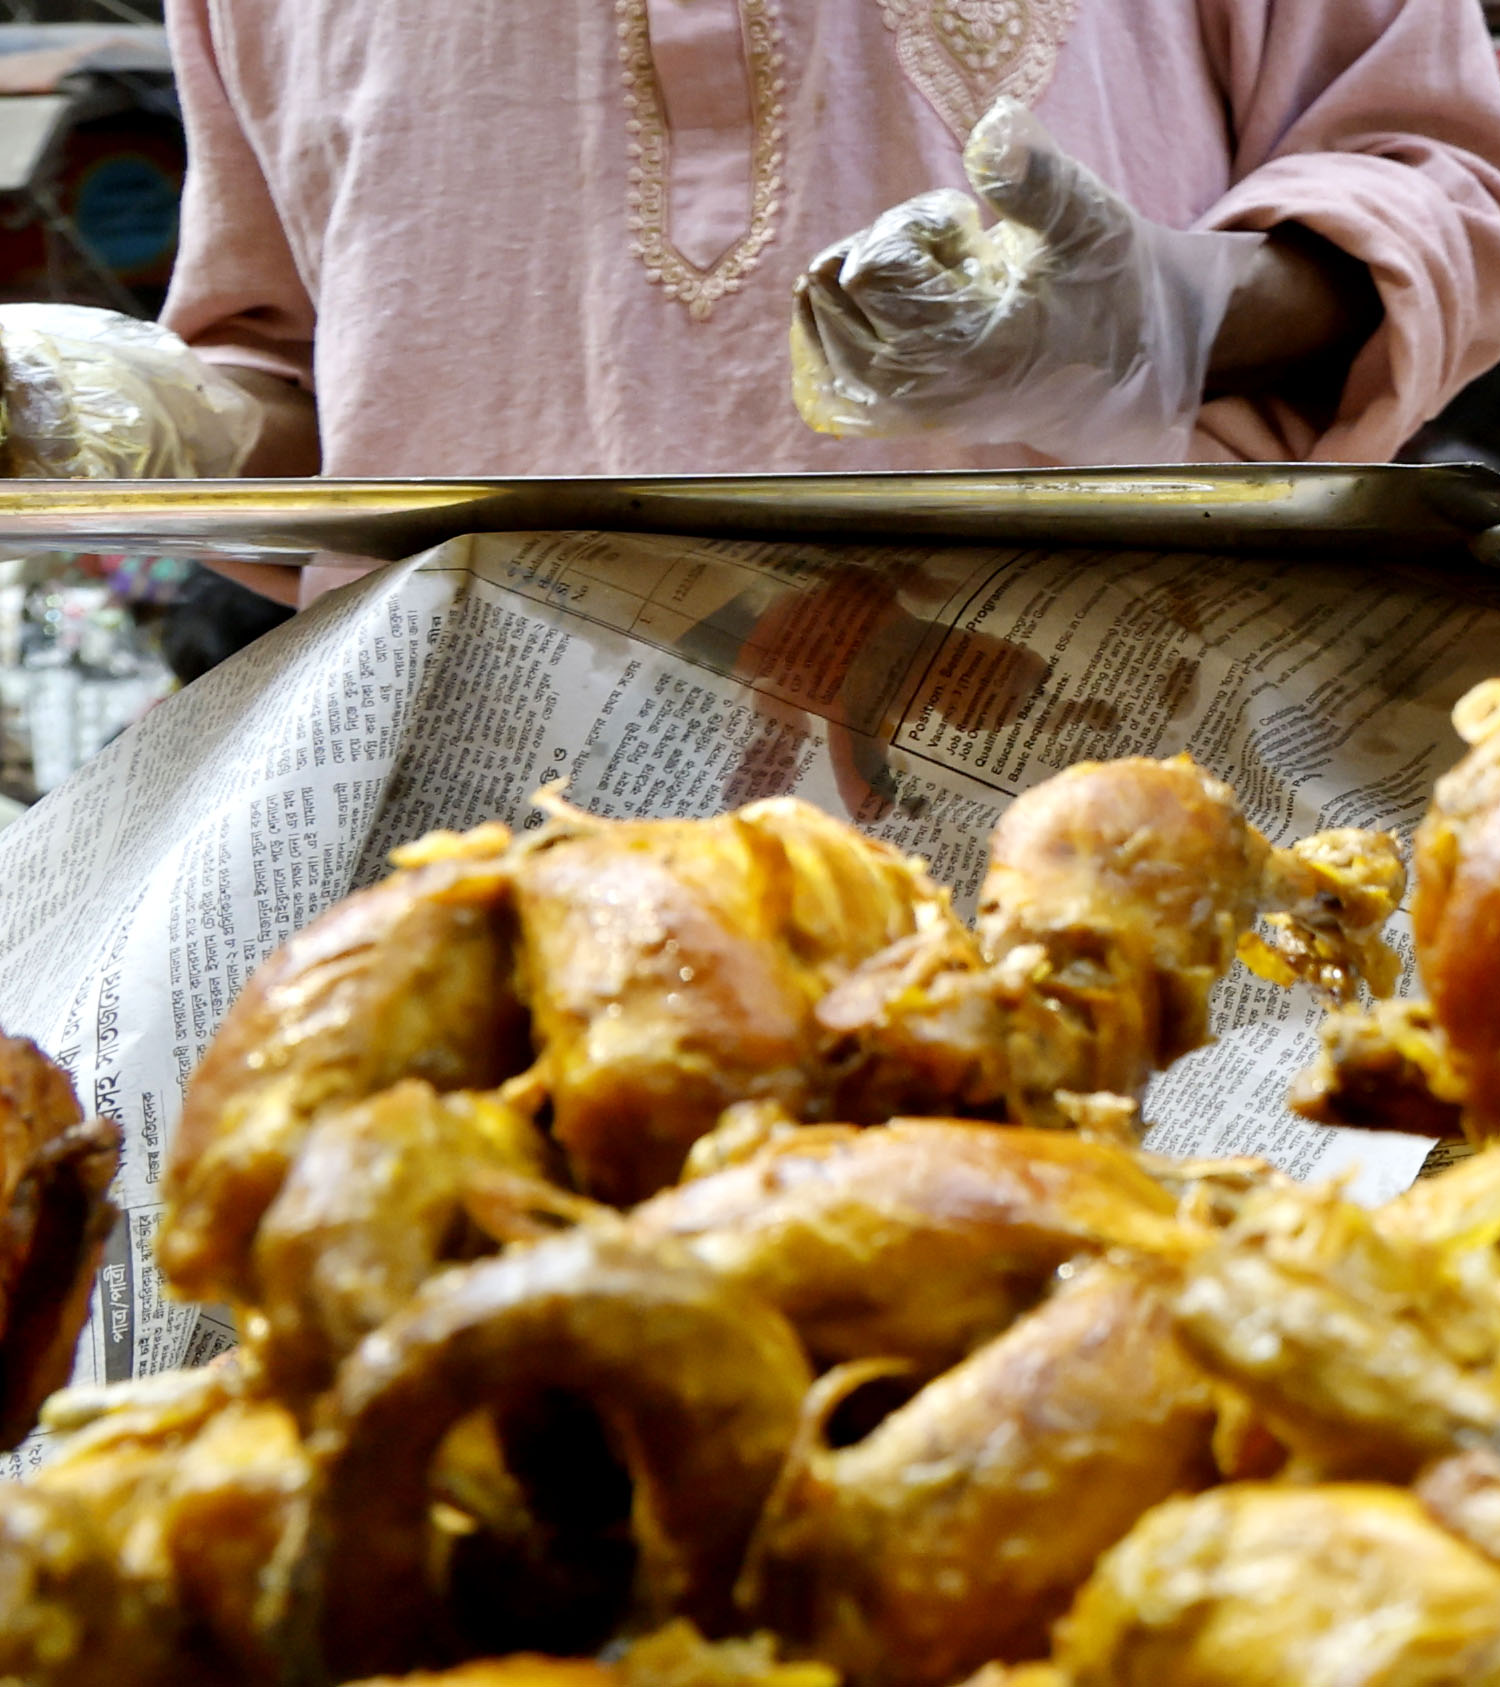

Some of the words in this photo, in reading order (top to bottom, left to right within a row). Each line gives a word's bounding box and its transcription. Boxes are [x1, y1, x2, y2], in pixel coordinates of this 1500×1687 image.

[990, 720, 1025, 775] Education
[1007, 748, 1029, 784] Basic
[1026, 672, 1073, 751] Requirements:
[102, 1262, 130, 1344] পাত্র/পাত্রী
